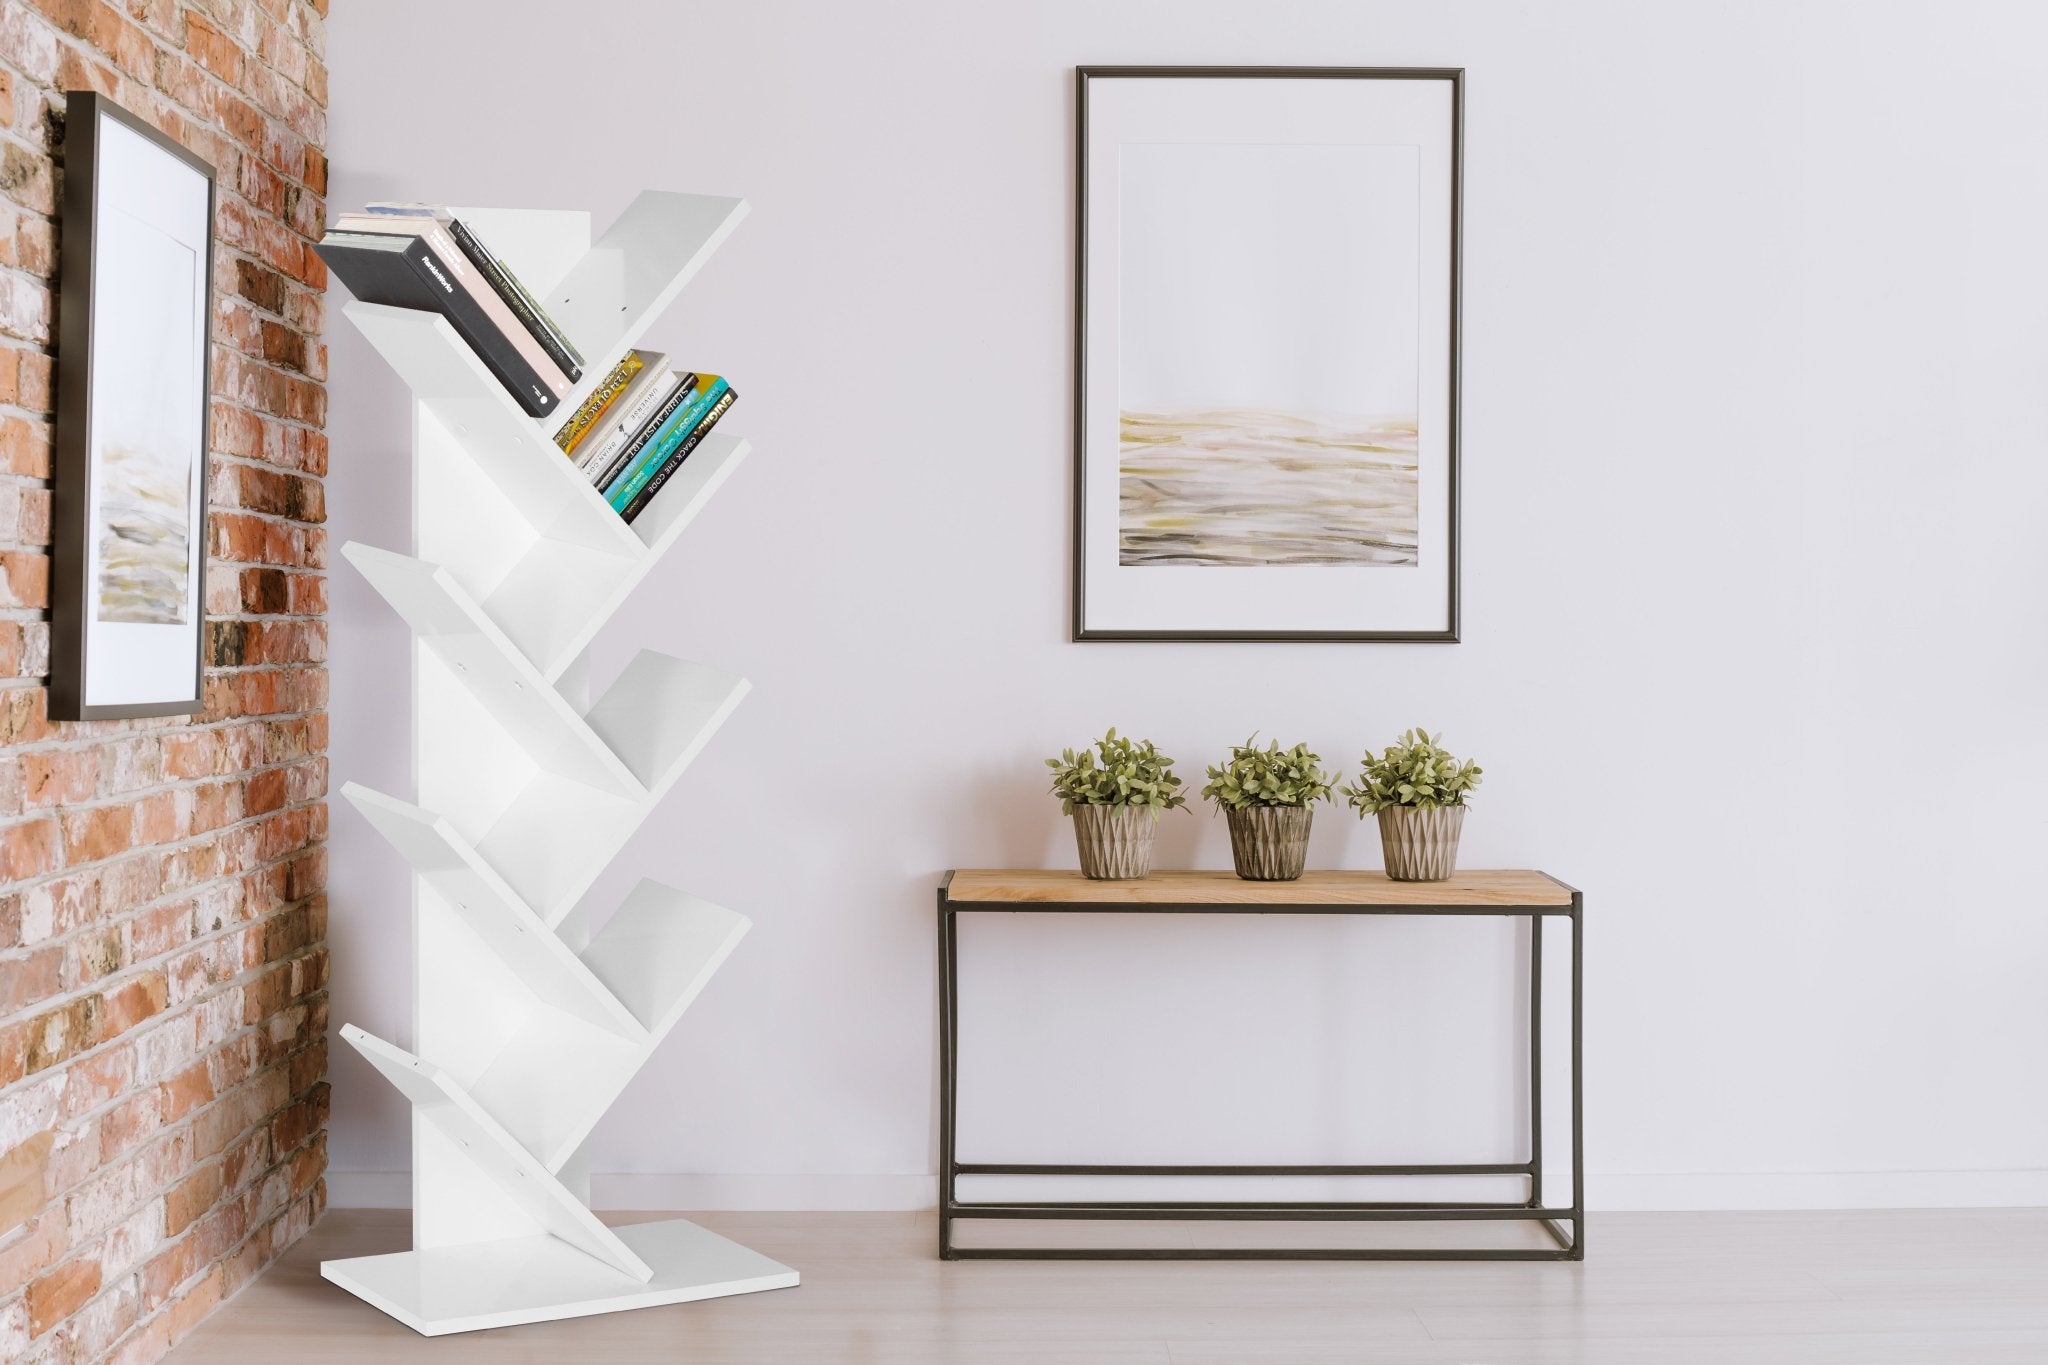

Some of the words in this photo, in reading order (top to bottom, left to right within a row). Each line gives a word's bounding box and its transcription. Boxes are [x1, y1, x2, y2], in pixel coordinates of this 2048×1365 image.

[420, 255, 455, 293] RankinWorks
[454, 225, 474, 247] Vivian
[470, 245, 489, 265] Maier
[484, 262, 503, 283] Street
[499, 281, 535, 322] Photographer
[608, 368, 629, 390] 1,234
[598, 387, 612, 401] QI
[628, 386, 659, 420] UNIVERSE
[704, 386, 721, 404] The
[578, 399, 603, 427] FACTS
[641, 386, 689, 440] SURREALIST
[673, 400, 708, 438] Squiggly
[597, 440, 617, 462] BRIAN
[626, 436, 646, 458] ART
[648, 437, 678, 469] Career
[675, 435, 697, 460] CRACK
[663, 459, 677, 474] THE
[646, 472, 666, 493] CODE
